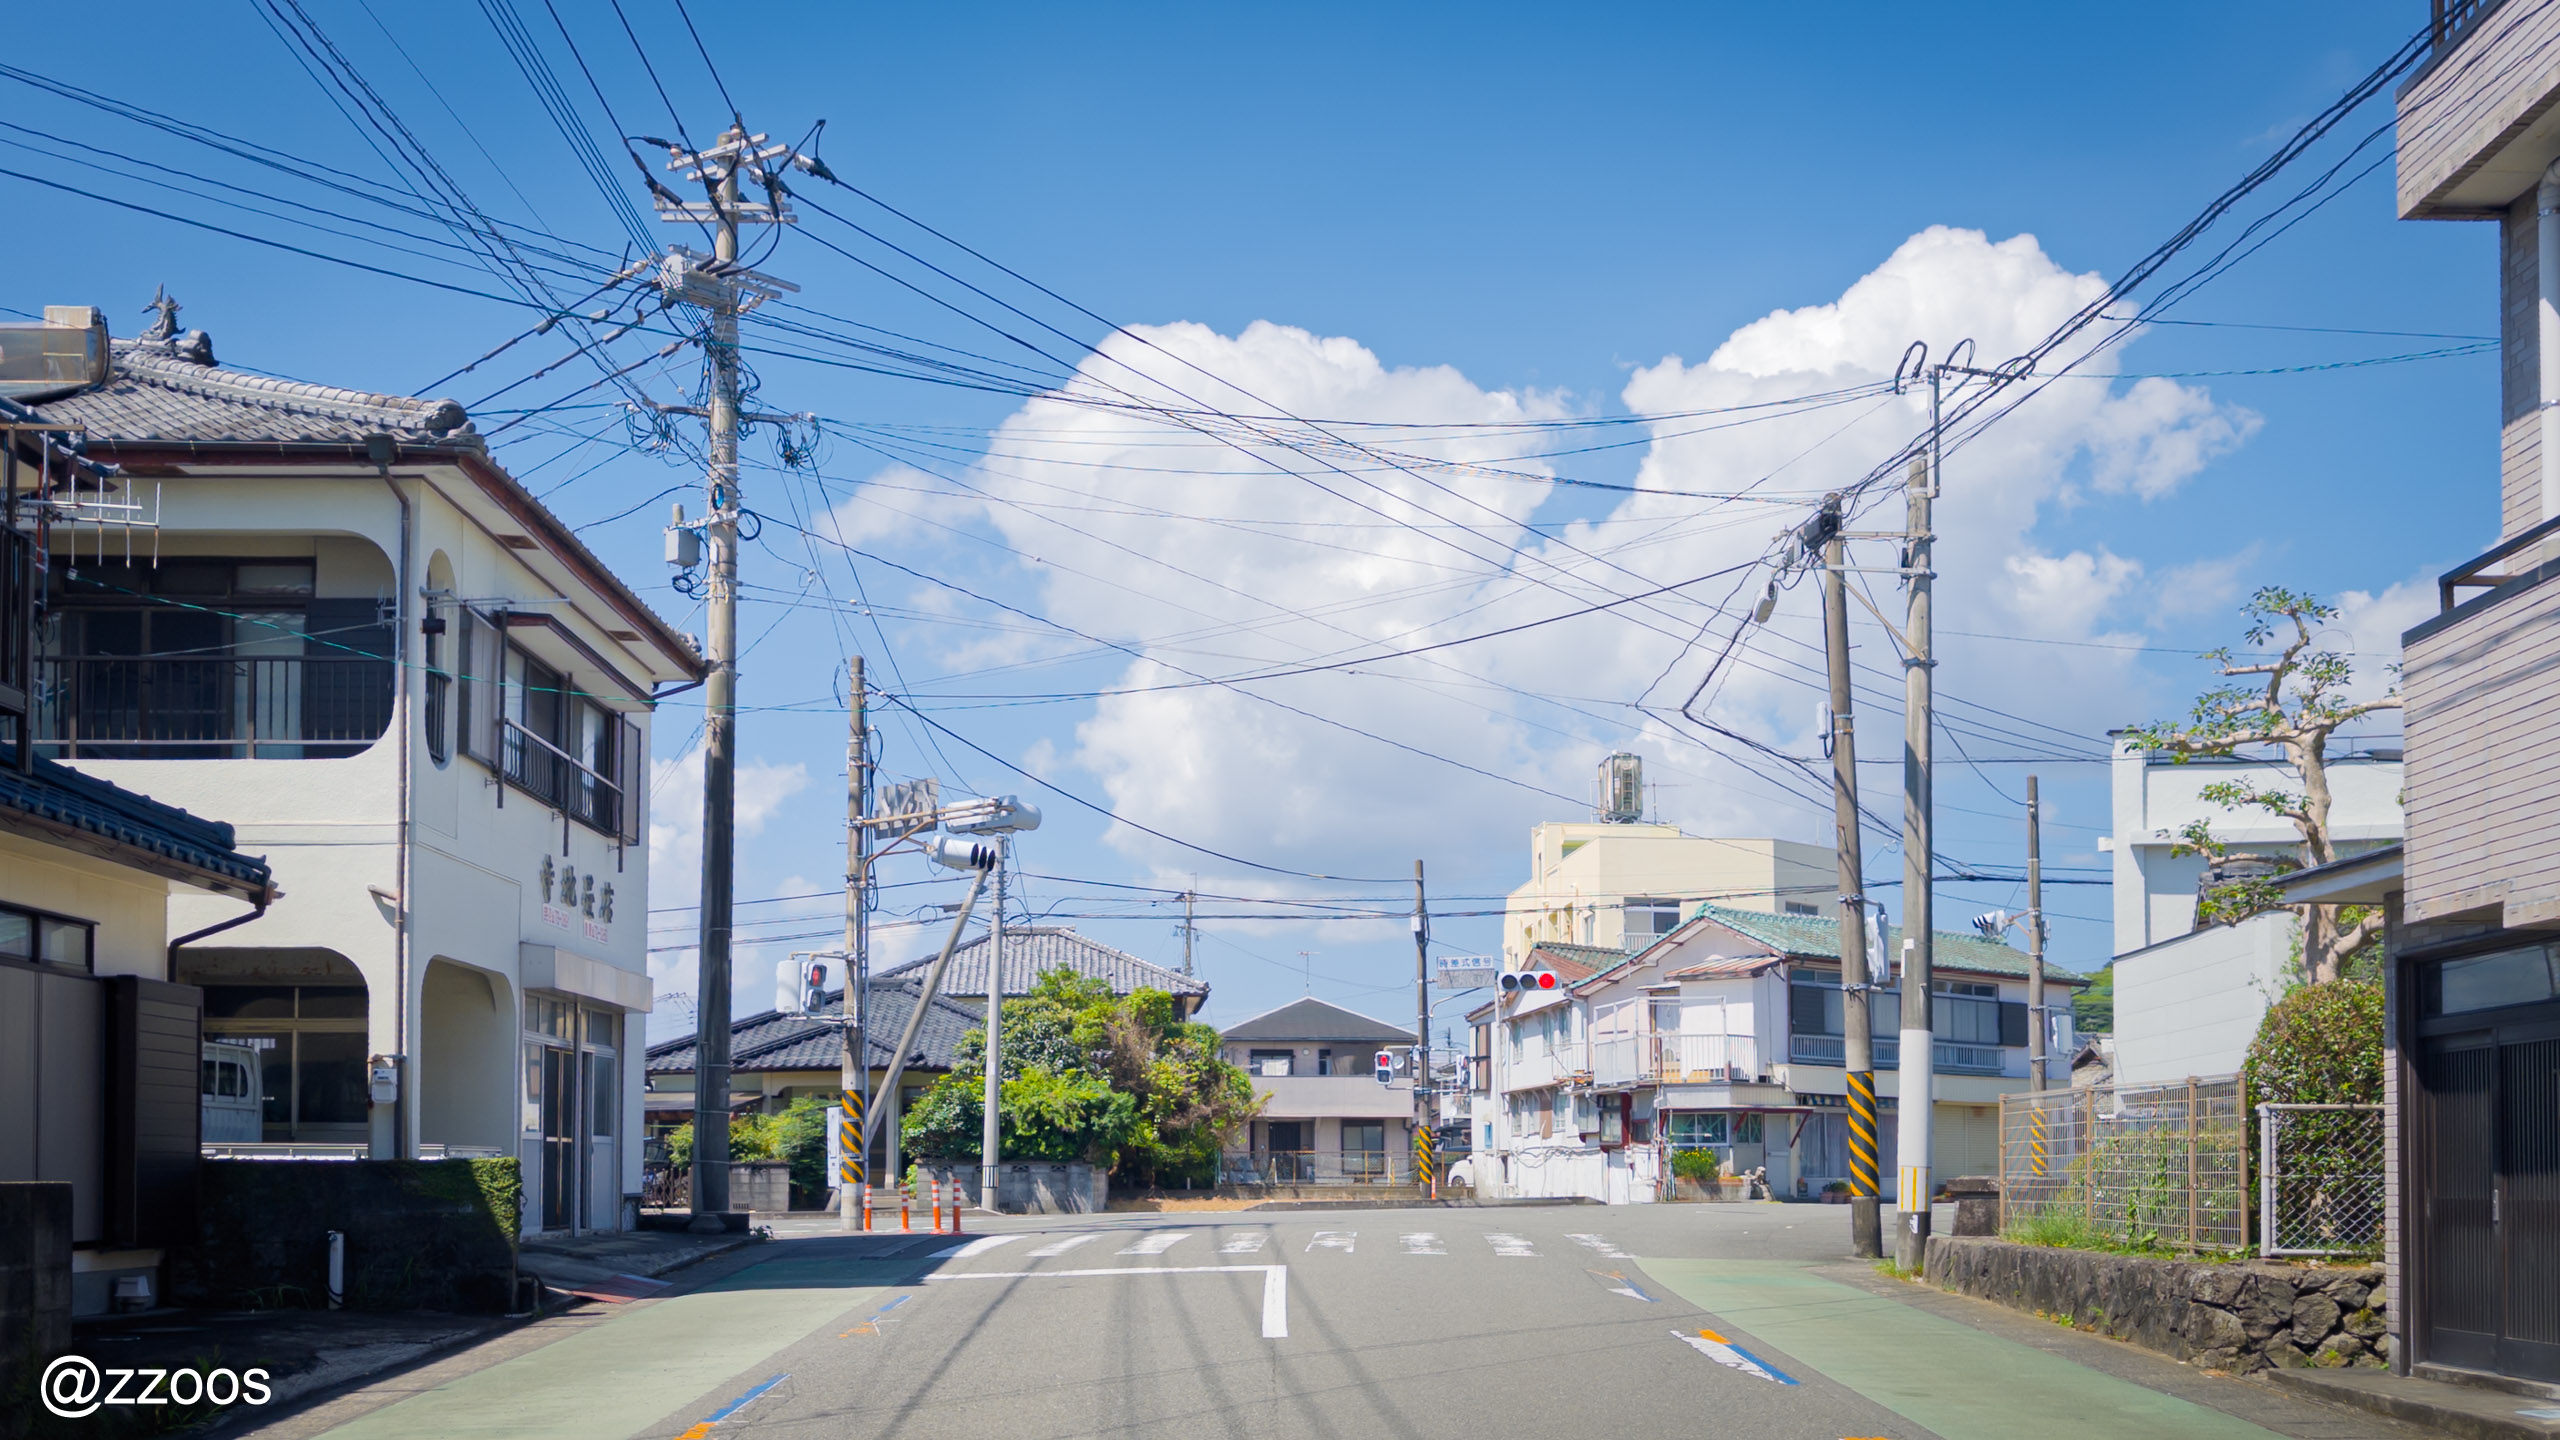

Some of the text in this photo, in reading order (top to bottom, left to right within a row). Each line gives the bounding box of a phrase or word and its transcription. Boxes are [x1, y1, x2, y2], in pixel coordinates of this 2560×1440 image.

[1439, 957, 1492, 968] 時差式信号
